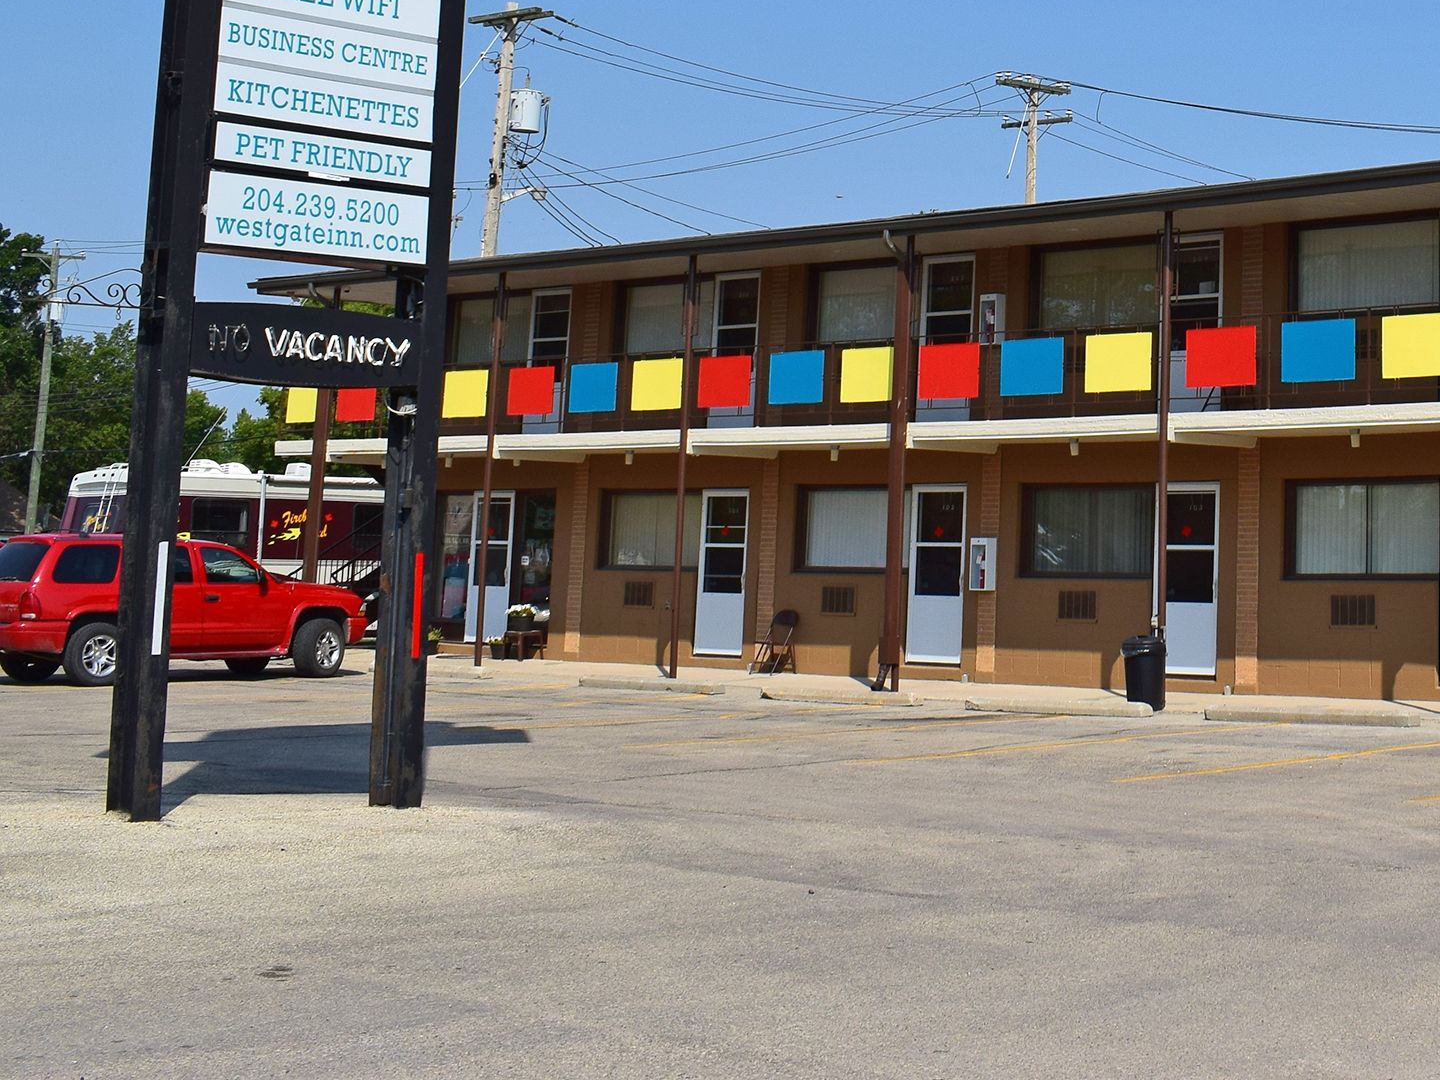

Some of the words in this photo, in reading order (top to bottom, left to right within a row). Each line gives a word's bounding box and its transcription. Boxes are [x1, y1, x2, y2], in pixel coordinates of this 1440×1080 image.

[227, 22, 335, 60] BUSINESS
[341, 42, 428, 76] CENTRE
[227, 79, 419, 129] KITCHENETTES
[235, 133, 284, 161] PET
[291, 141, 412, 178] FRIENDLY
[242, 186, 400, 226] 204.239.5200
[216, 216, 420, 254] westgateinn.com
[208, 323, 250, 352] NO
[264, 326, 411, 366] VACANCY
